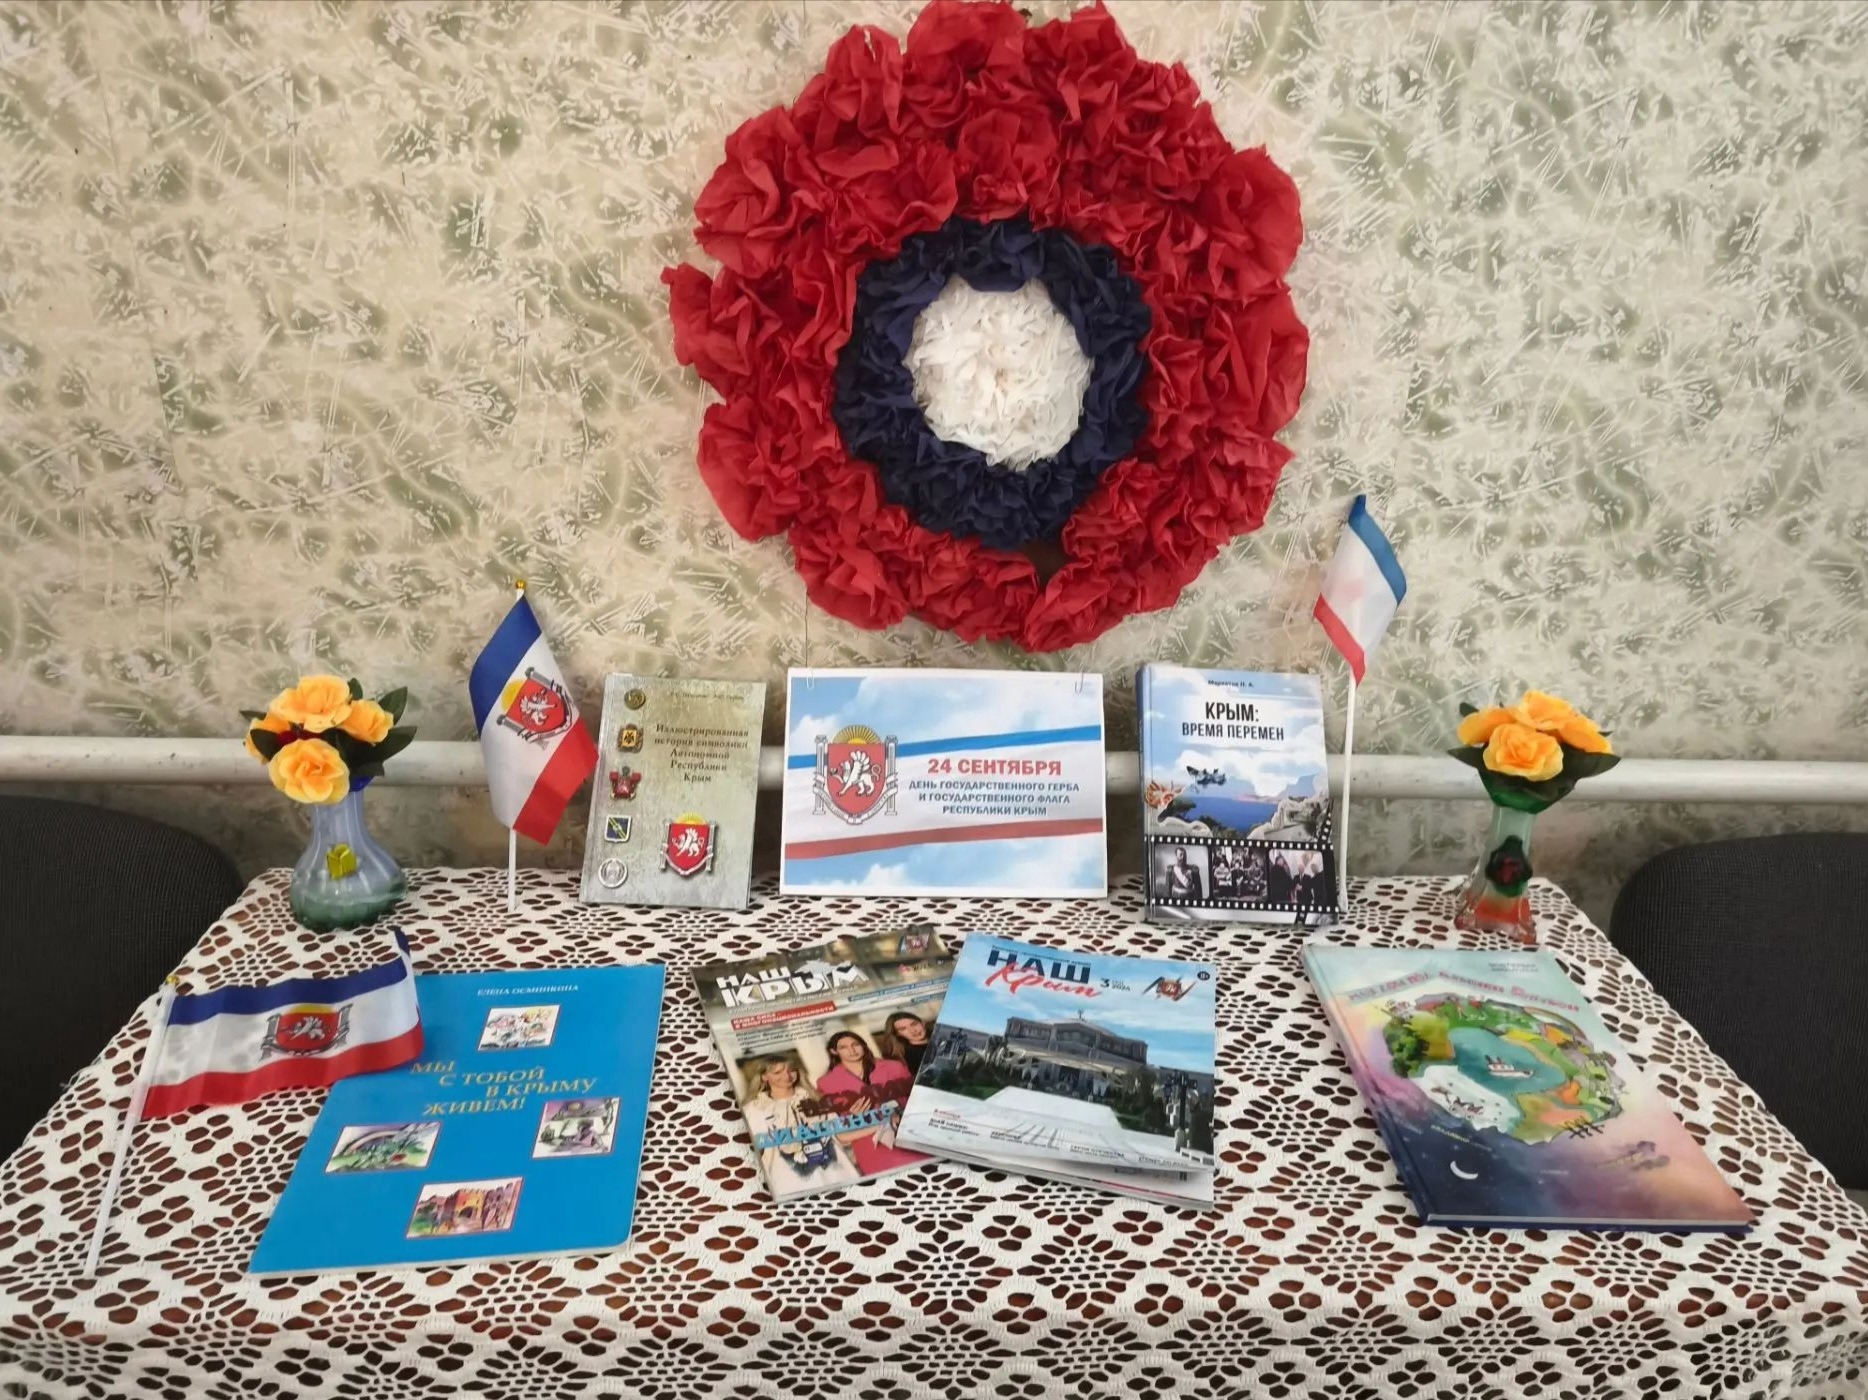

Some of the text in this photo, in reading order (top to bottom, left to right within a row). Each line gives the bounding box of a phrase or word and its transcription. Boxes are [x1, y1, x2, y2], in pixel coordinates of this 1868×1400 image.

[1205, 701, 1259, 722] КРЫМ:
[656, 724, 749, 737] Иллюстрированная
[1182, 722, 1284, 741] ВРЕМЯ ПЕРЕМЕН
[654, 738, 748, 749] история символики
[670, 748, 730, 759] Автономной
[670, 760, 727, 771] Республики
[927, 758, 1062, 776] 24 СЕНТЯБРЯ
[684, 772, 712, 783] Крым
[909, 780, 1080, 792] ДЕНЬ ГОСУДАРСТВЕННОГО ГЕРБА
[919, 793, 1070, 804] И ГОСУДАРСТВЕННОГО ФЛАГА
[942, 805, 1047, 816] РЕСПУБЛИКИ КРЫМ
[987, 949, 1092, 984] НАШ
[716, 966, 791, 991] НАШ
[1100, 977, 1110, 988] 3
[721, 964, 869, 1008] КРЫМ
[410, 1060, 455, 1074] МЫ
[439, 1066, 546, 1086] С ТОБОЙ
[486, 1077, 597, 1098] В КРЫМУ
